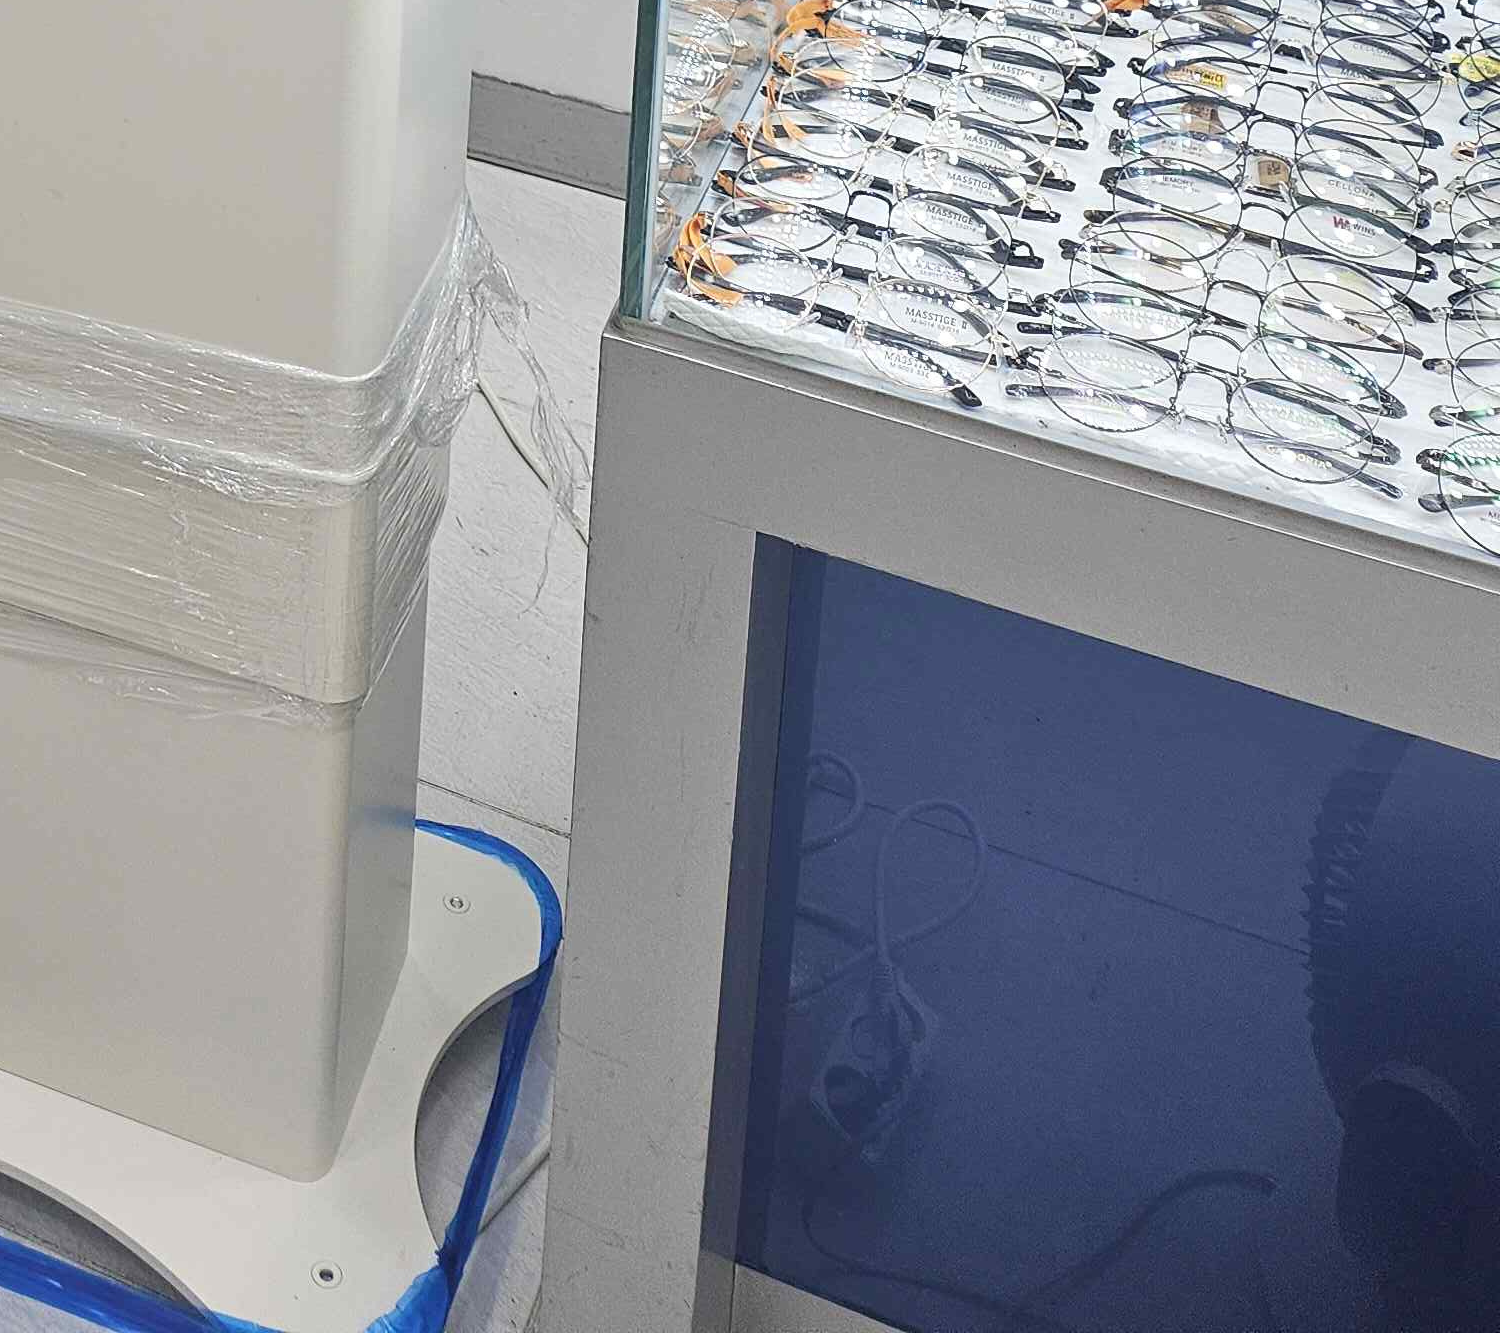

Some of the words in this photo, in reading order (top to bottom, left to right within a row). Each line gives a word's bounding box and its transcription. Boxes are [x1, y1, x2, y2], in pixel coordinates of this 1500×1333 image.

[1328, 178, 1376, 199] CELLONA
[925, 204, 974, 225] MASSTIGE
[905, 306, 957, 326] MASSTIGE
